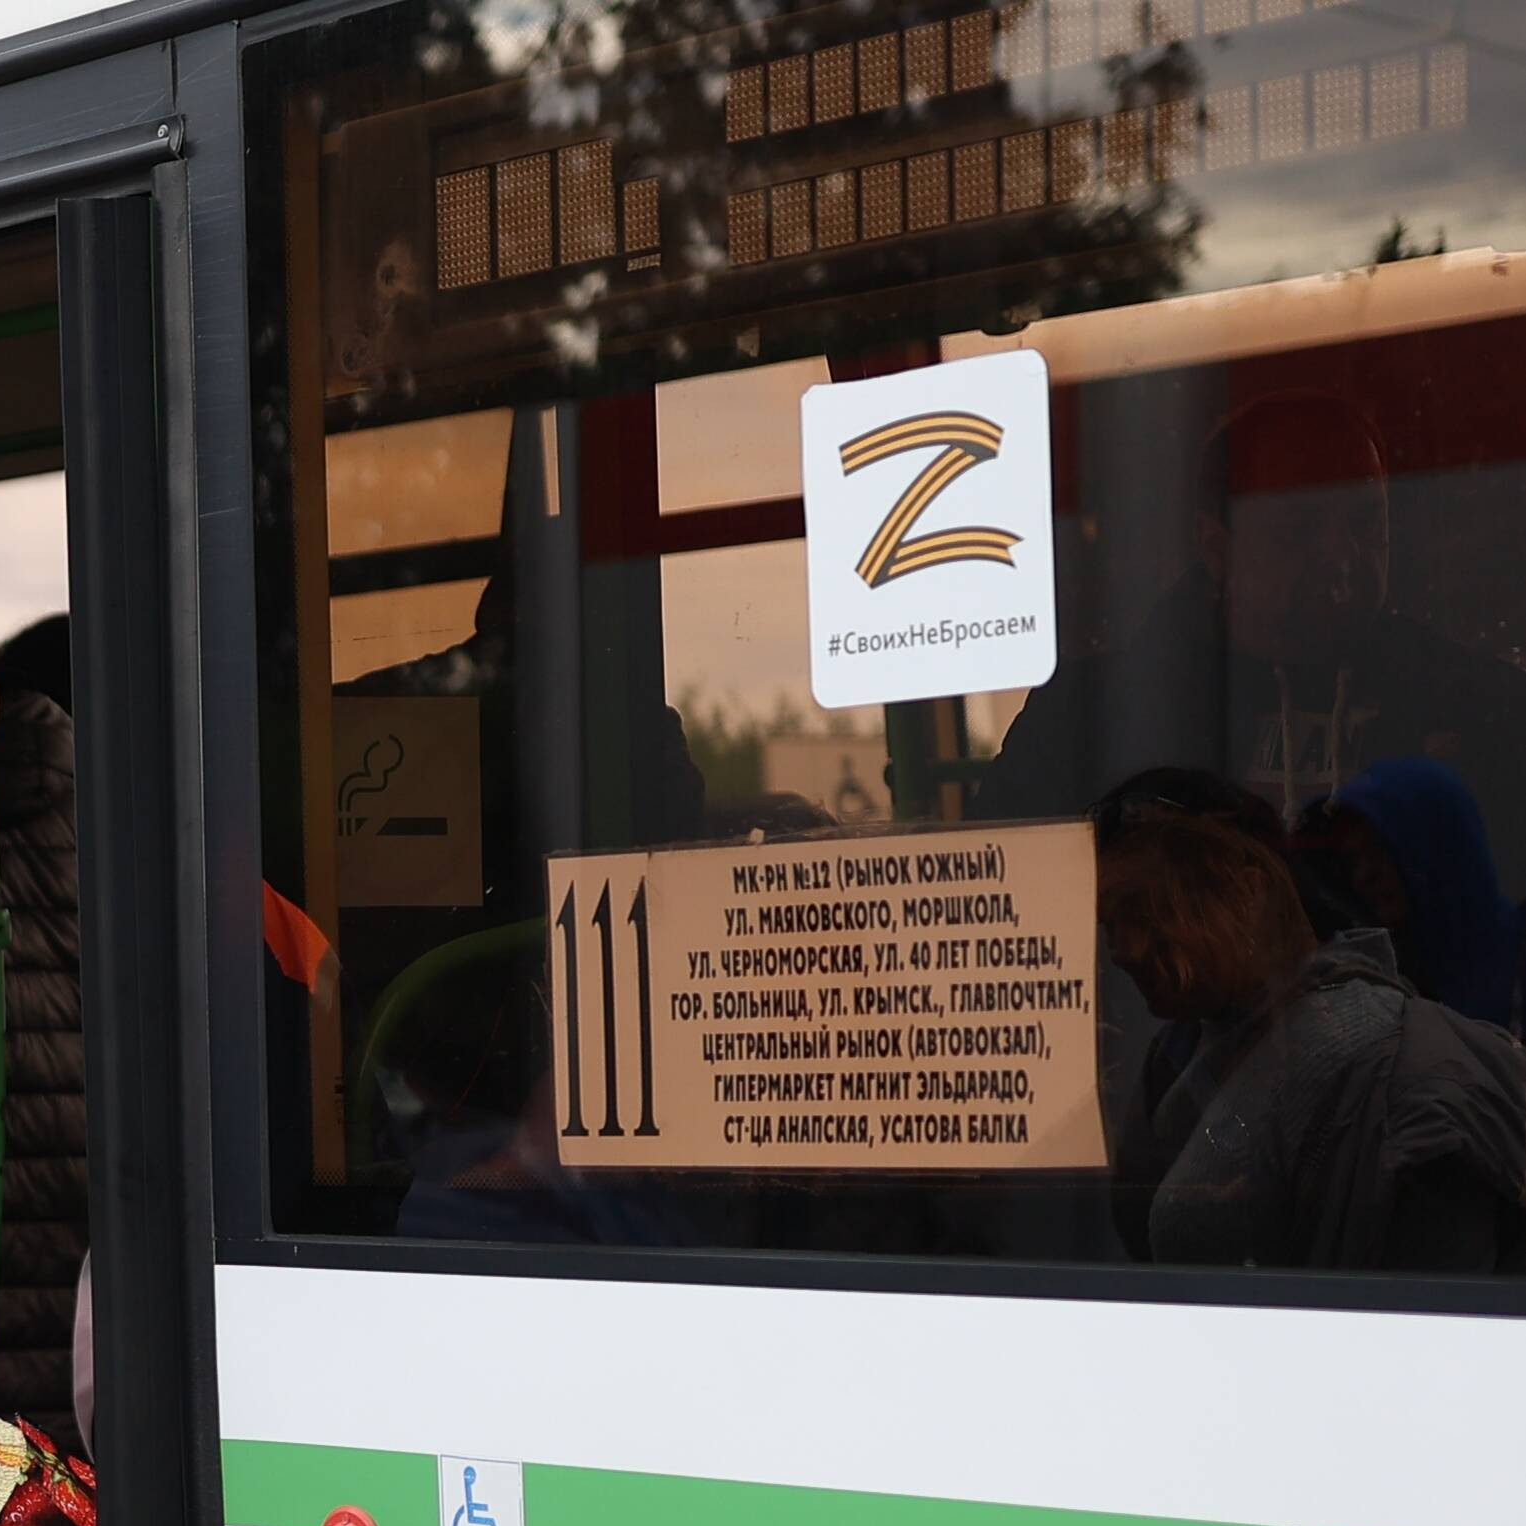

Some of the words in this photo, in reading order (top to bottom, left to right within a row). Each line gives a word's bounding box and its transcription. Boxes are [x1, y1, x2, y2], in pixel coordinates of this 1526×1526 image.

[838, 410, 1025, 590] Z
[828, 613, 1037, 657] #СвоихНеБросаем
[792, 860, 831, 891] №12
[836, 855, 912, 892] (РЫНОК
[915, 843, 1005, 884] ЮЖНЫЙ)
[724, 907, 754, 937] УЛ.
[758, 899, 897, 935] МАЯКОВСКОГО,
[902, 892, 1019, 928] МОРШКОЛА,
[687, 950, 717, 980] УЛ.
[720, 943, 869, 978] ЧЕРНОМОРСКАЯ,
[873, 942, 905, 973] УЛ.
[909, 940, 931, 971] 40
[935, 939, 970, 970] ЛЕТ
[975, 935, 1063, 971] ПОБЕДЫ,
[555, 876, 660, 1137] 111
[670, 992, 708, 1021] ГОР.
[712, 988, 814, 1022] БОЛЬНИЦА,
[817, 987, 848, 1017] УЛ.
[853, 984, 945, 1018] КРЫМСК.,
[950, 979, 1089, 1014] ГЛАВПОЧТАМТ,
[702, 1023, 831, 1065] ЦЕНТРАЛЬНЫЙ
[836, 1028, 903, 1059] РЫНОК
[907, 1020, 1051, 1061] (АВТОВОКЗАЛ),
[714, 1072, 835, 1102] ГИПЕРМАРКЕТ
[840, 1071, 912, 1101] МАГНИТ
[916, 1069, 1034, 1105] ЭЛЬДАРАДО,
[776, 1114, 875, 1149] АНАПСКАЯ,
[879, 1113, 963, 1144] УСАТОВА
[967, 1113, 1029, 1144] БАЛКА
